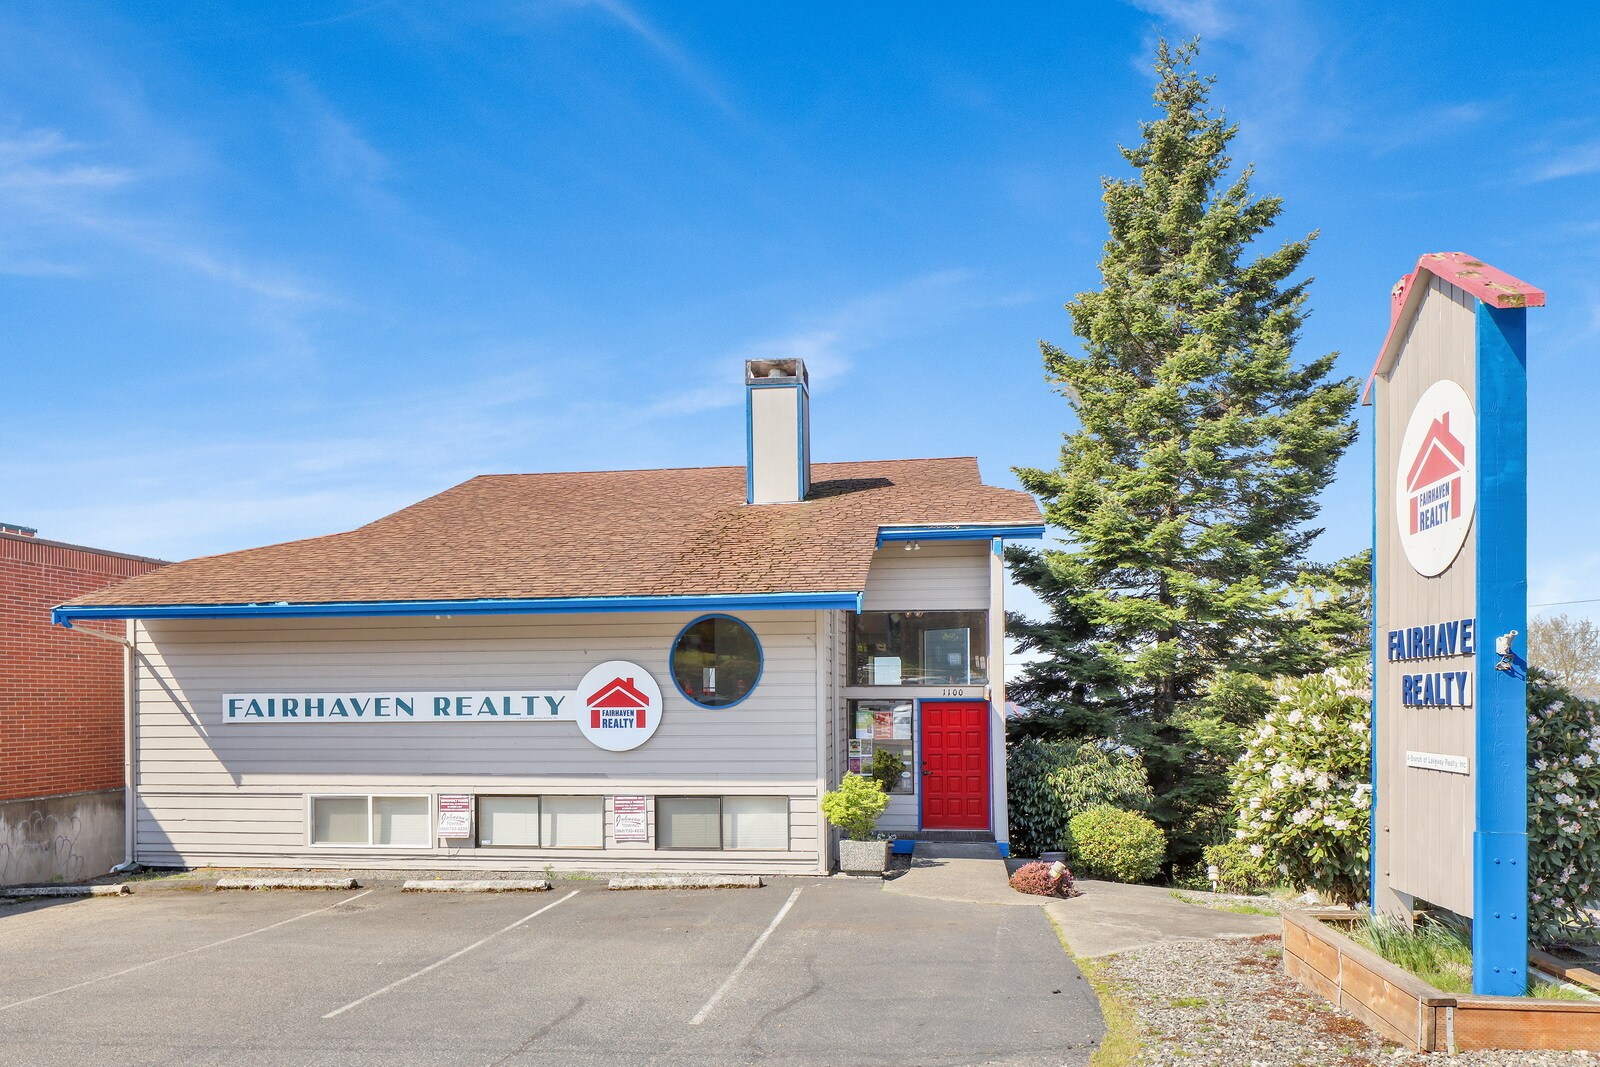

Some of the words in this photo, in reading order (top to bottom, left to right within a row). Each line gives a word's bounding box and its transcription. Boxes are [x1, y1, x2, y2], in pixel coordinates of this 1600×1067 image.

[1420, 481, 1449, 507] FAIRHAVEN
[1420, 500, 1449, 532] REALTY
[1388, 618, 1476, 660] FAIRHAVE
[943, 688, 963, 696] 1100
[1402, 671, 1467, 705] REALTY
[228, 697, 415, 718] FAIRHAVEN
[433, 695, 566, 717] REALTY
[602, 709, 634, 717] FAIRHAVEN
[602, 718, 634, 728] REALTY
